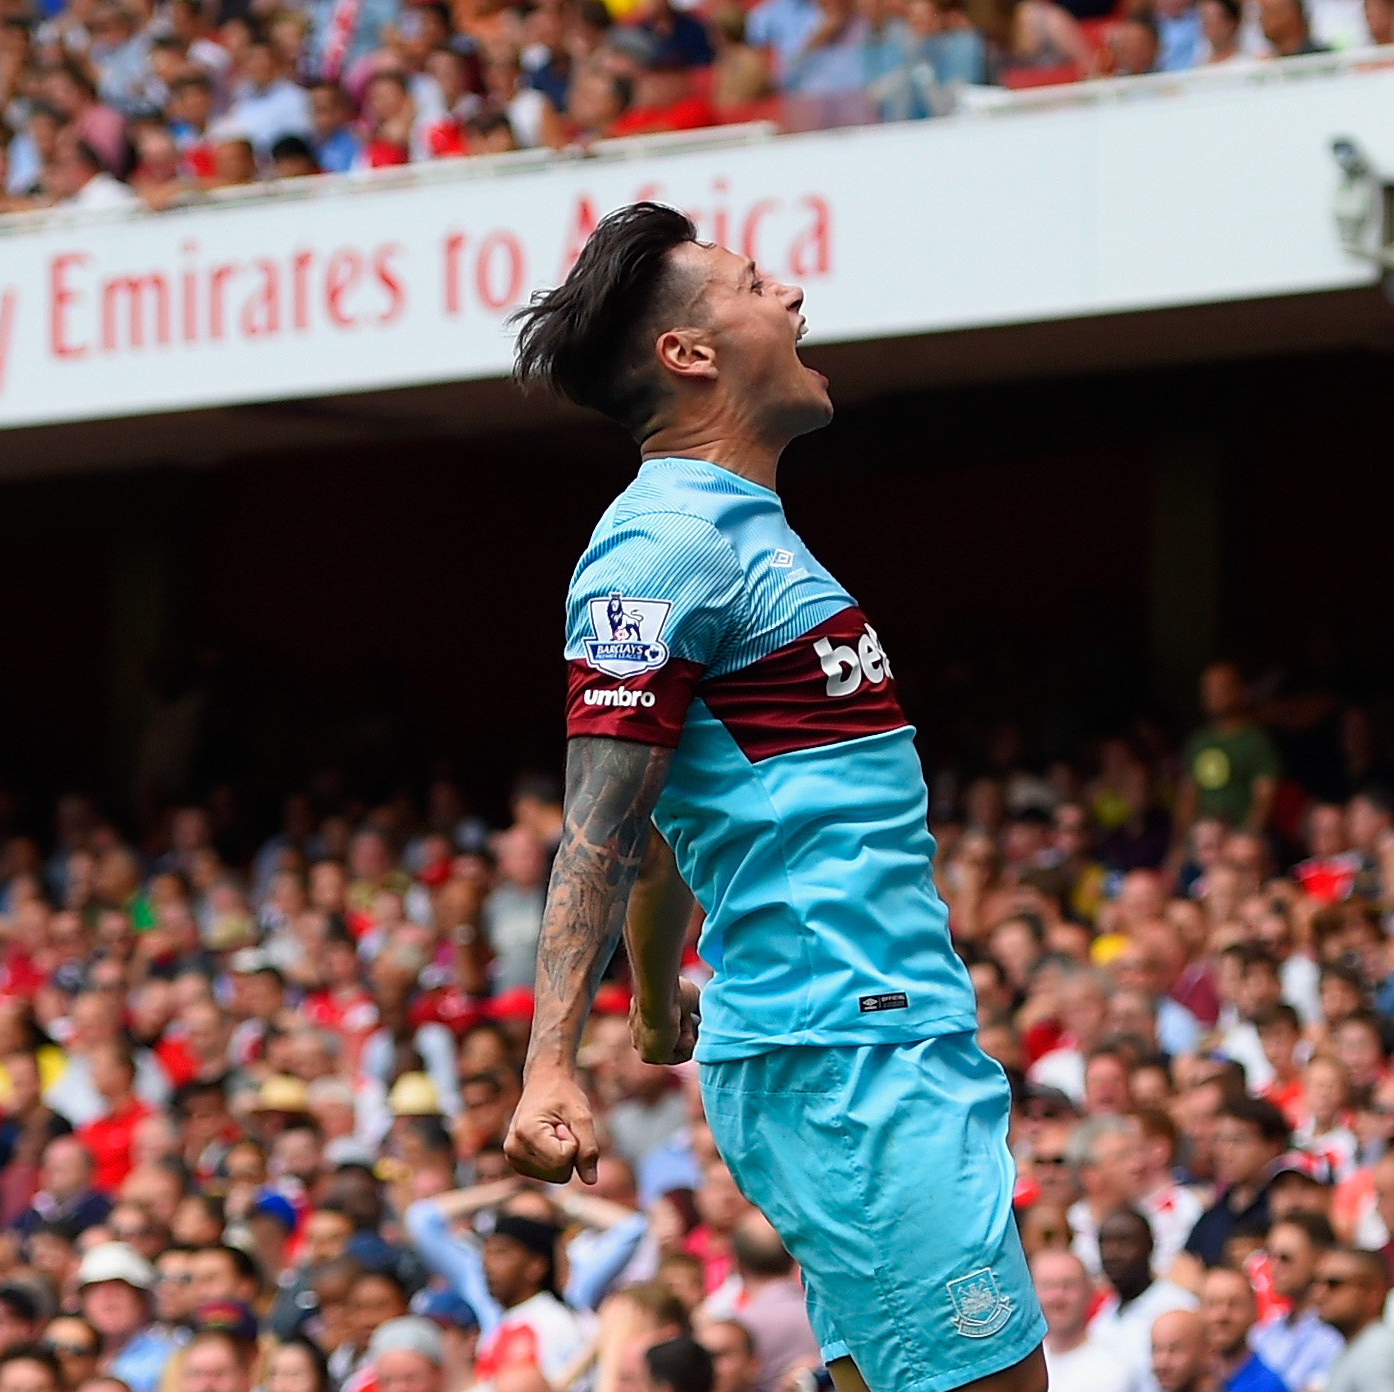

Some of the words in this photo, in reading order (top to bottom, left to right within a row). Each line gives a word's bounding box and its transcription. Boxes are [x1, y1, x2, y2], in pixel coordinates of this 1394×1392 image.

[48, 241, 405, 361] Emirates
[441, 227, 526, 313] to
[558, 175, 834, 284] Aica
[597, 644, 644, 655] BARCLAYS
[583, 685, 655, 707] umbro
